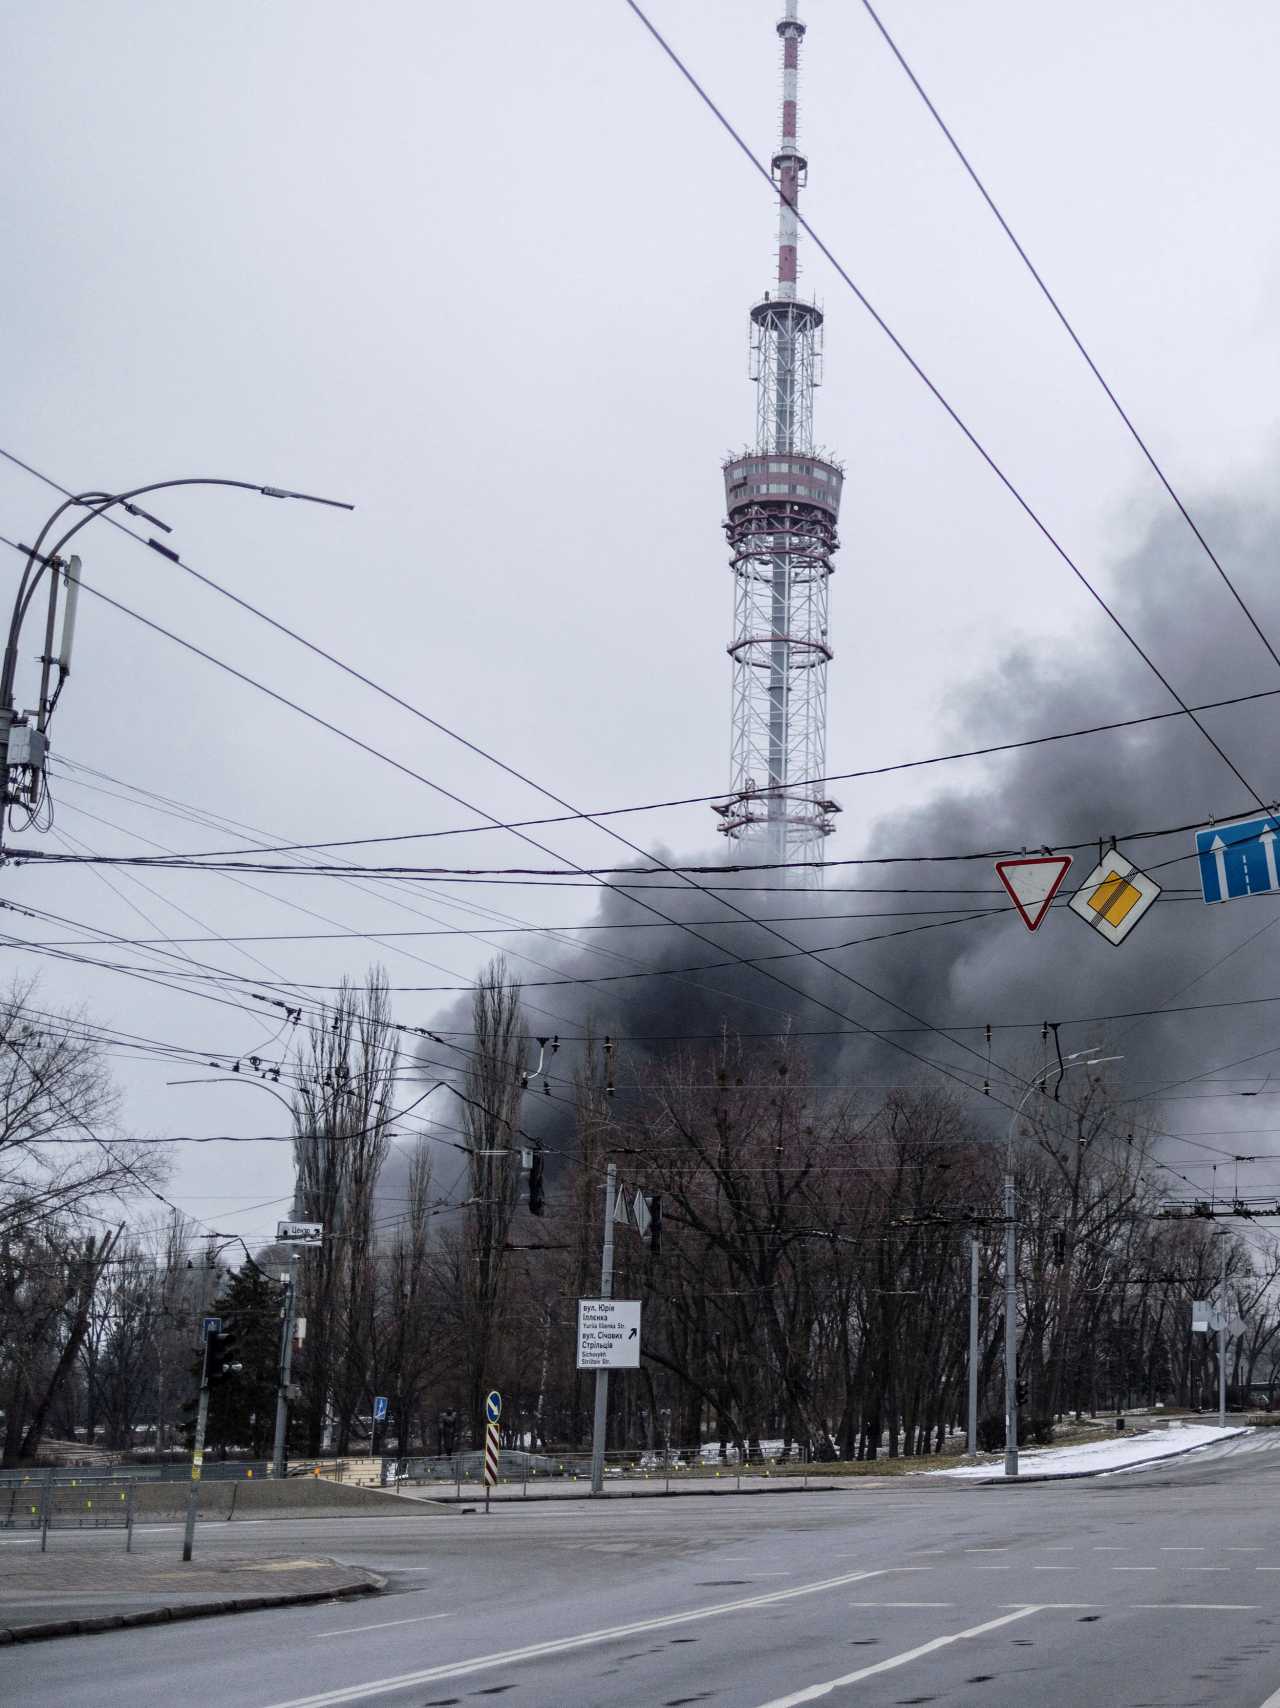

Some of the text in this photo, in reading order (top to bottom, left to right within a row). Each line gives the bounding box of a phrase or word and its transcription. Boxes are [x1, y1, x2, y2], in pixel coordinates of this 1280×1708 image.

[583, 1303, 615, 1313] вул. Юрія
[582, 1331, 622, 1341] вул. Січових
[582, 1340, 613, 1350] Стрільців
